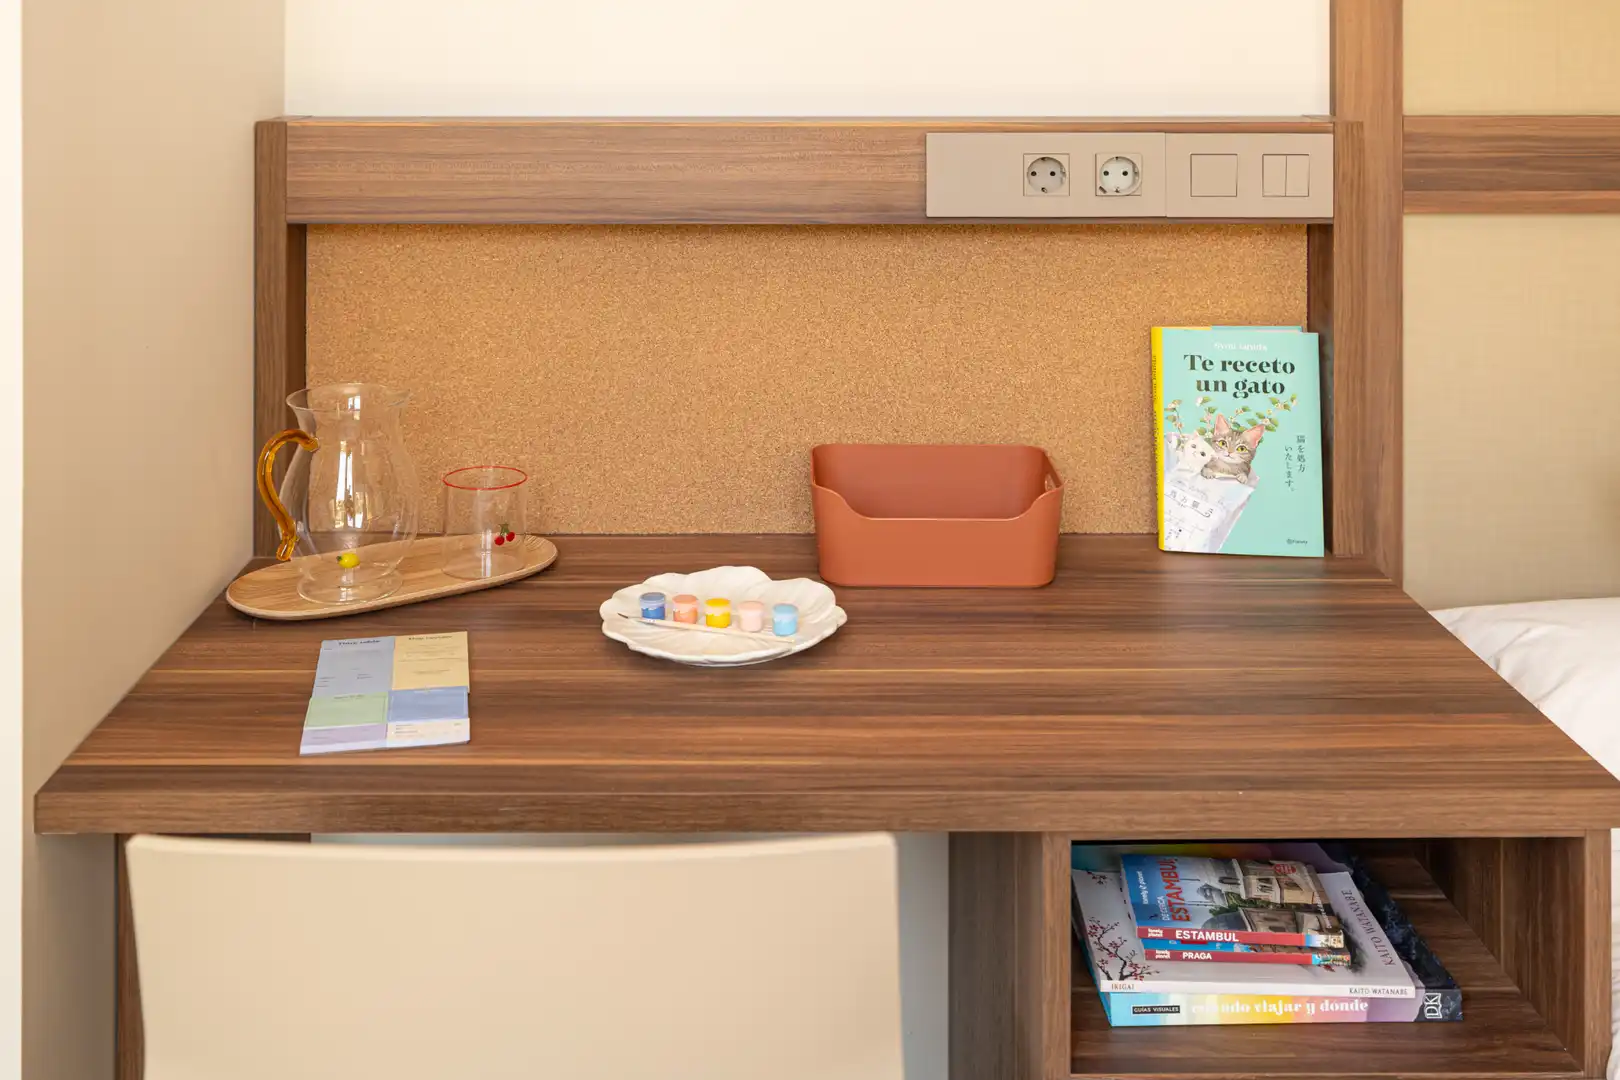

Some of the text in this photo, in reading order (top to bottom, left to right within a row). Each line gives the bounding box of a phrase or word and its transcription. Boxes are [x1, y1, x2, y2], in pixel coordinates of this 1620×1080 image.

[1183, 354, 1296, 374] Te receto
[1196, 377, 1286, 399] un gato
[1158, 857, 1192, 922] ESTAMBUL
[1175, 929, 1240, 943] ESTAMBUL
[1341, 890, 1396, 966] KAITO WATANABE
[1182, 951, 1213, 960] PRAGA
[1371, 987, 1409, 995] WATANABE
[1191, 999, 1251, 1013] cndo
[1305, 1001, 1317, 1016] y
